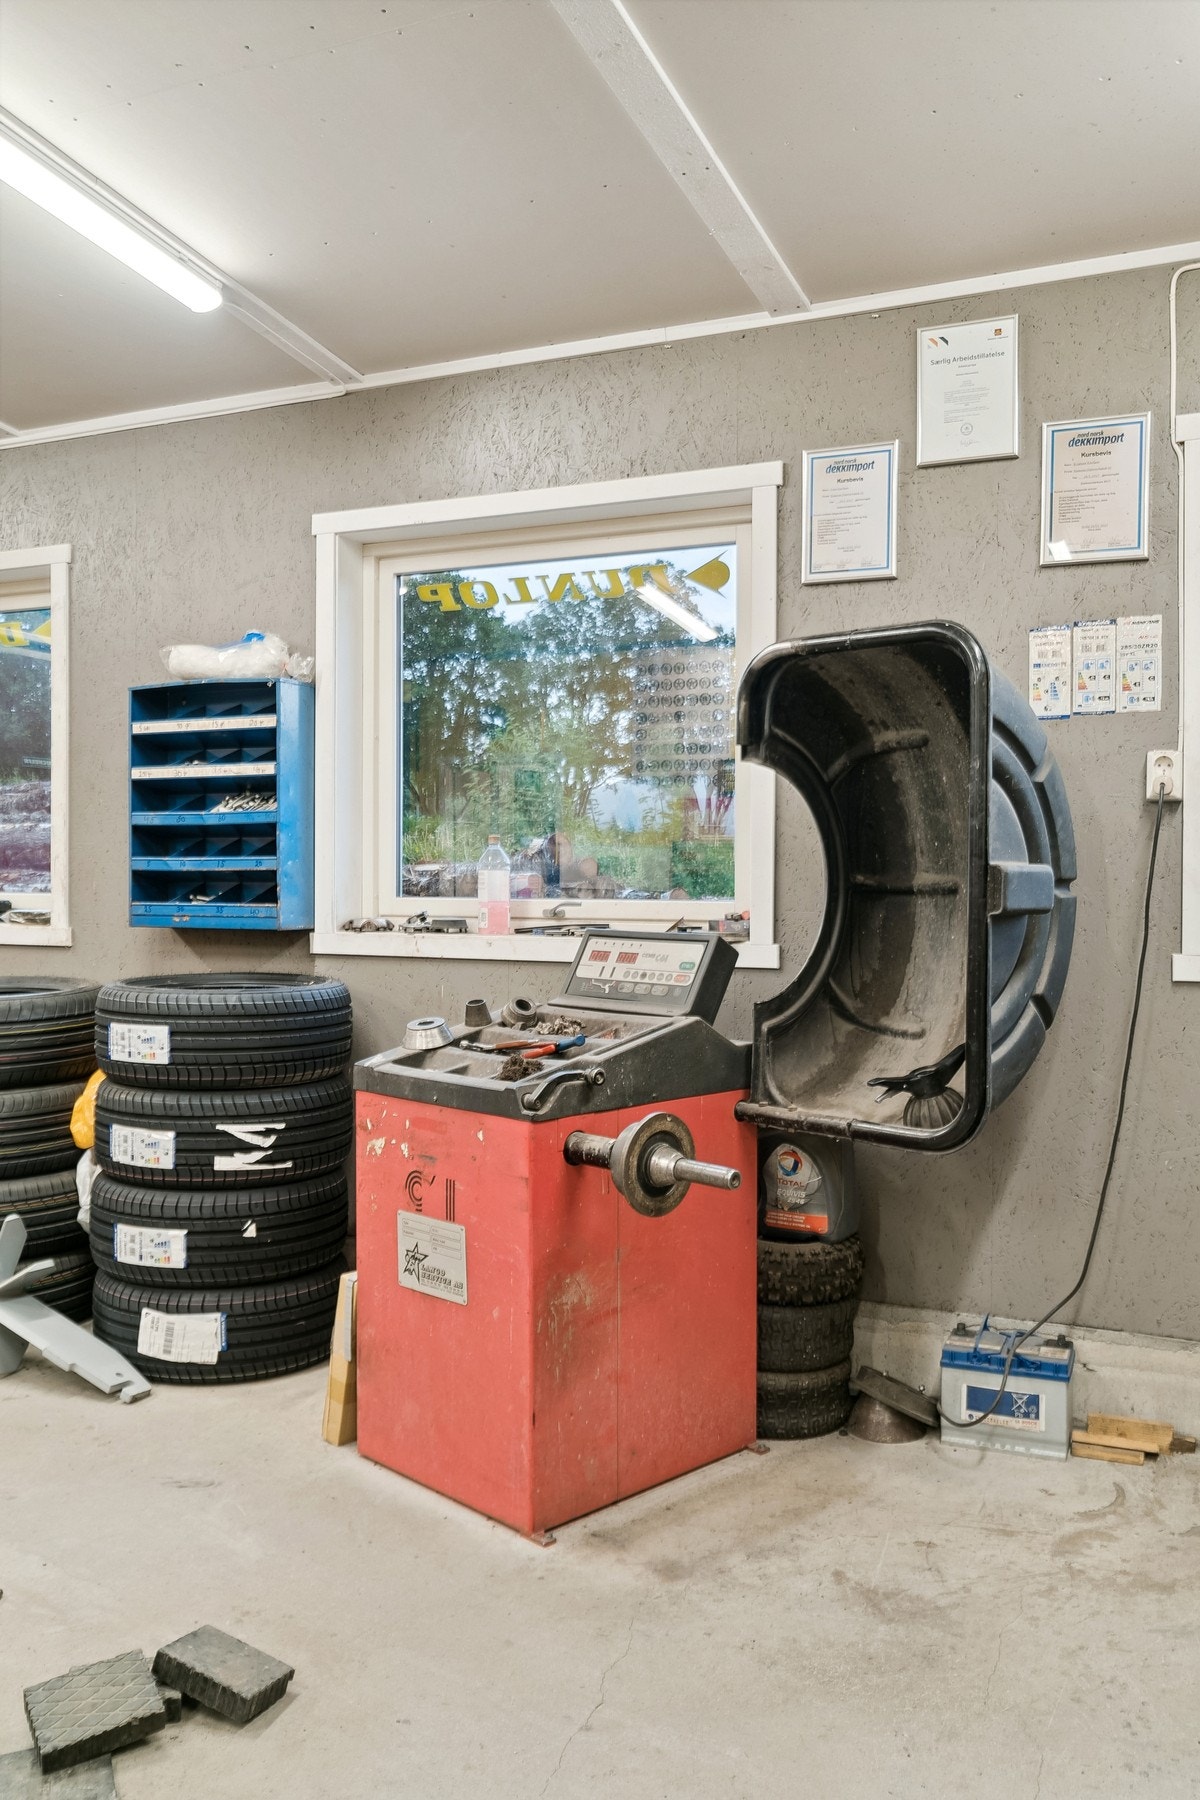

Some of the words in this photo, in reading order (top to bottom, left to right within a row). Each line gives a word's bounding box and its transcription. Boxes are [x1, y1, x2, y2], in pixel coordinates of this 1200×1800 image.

[930, 357, 951, 366] Særlig
[952, 351, 1005, 363] Arbeidstillatelse
[1068, 433, 1125, 447] dekkimport
[1081, 450, 1112, 458] Kursbevis
[826, 460, 875, 474] dekkimport
[777, 1178, 805, 1188] TOTAL
